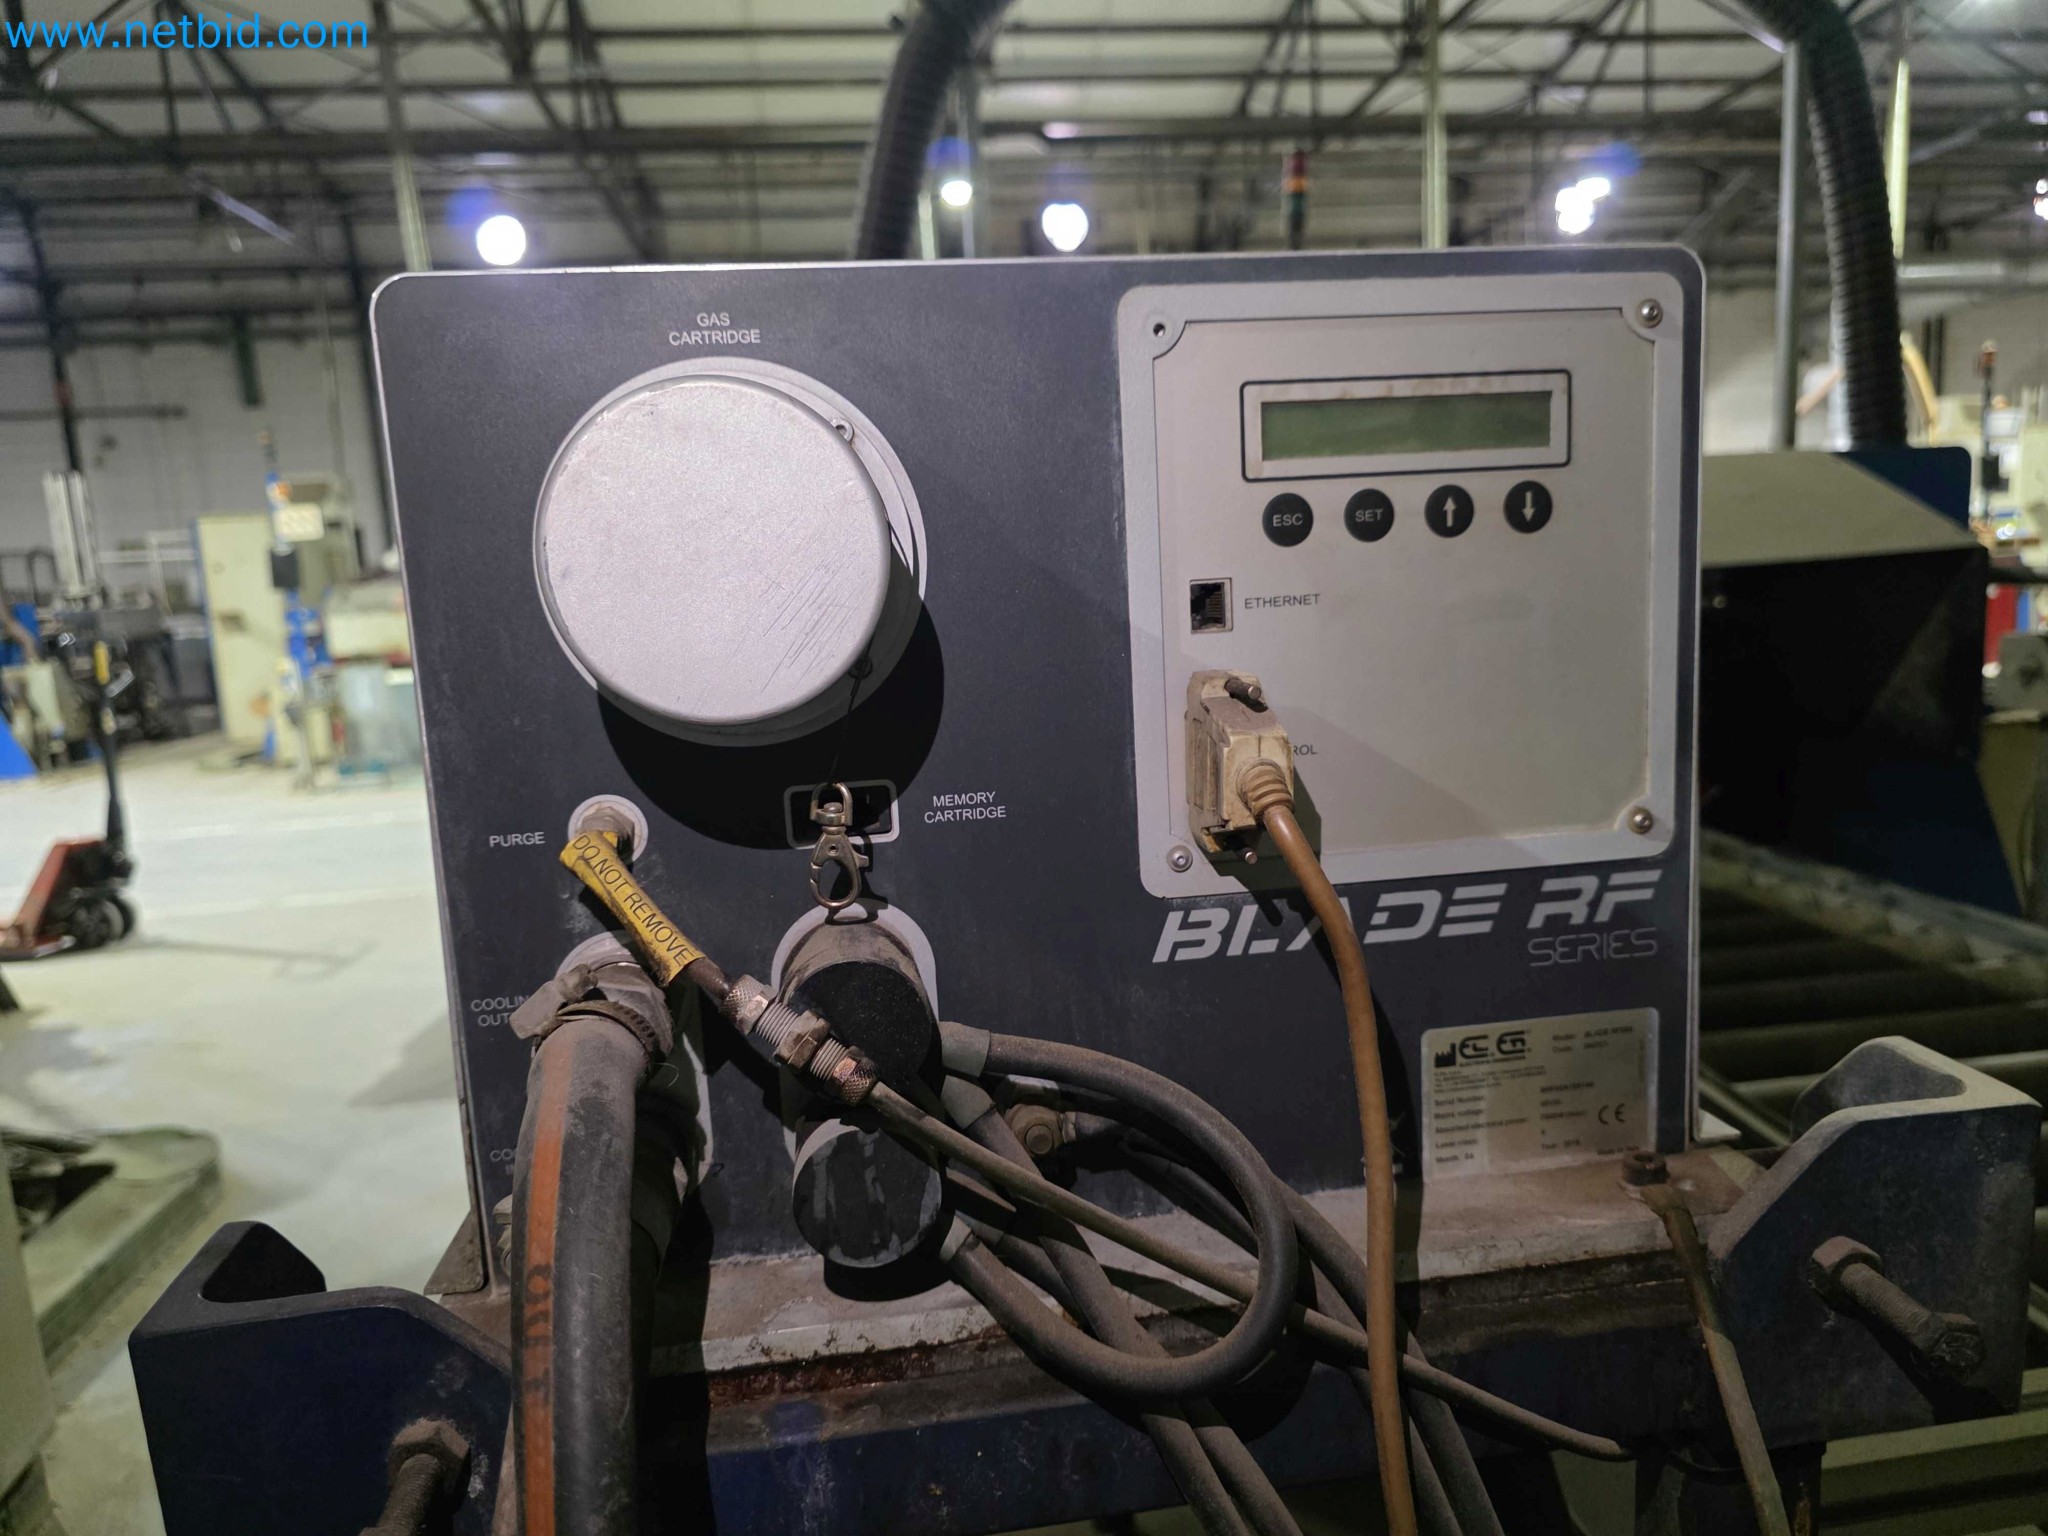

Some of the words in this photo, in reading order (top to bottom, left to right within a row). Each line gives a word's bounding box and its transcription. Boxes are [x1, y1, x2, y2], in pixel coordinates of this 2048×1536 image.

[696, 312, 731, 327] GAS
[668, 329, 761, 346] CARTRIDGE
[1272, 513, 1304, 527] ESC
[1354, 508, 1384, 523] SET
[1244, 594, 1321, 610] ETHERNET
[932, 791, 996, 807] MEMORY
[923, 806, 1007, 823] CARTRIDGE
[489, 831, 546, 848] PURGE
[572, 834, 600, 861] DO
[592, 858, 633, 893] NOT
[623, 892, 695, 967] REMOVE
[1526, 869, 1663, 929] RF
[1527, 927, 1659, 967] SERIES
[470, 995, 532, 1012] COOLIN
